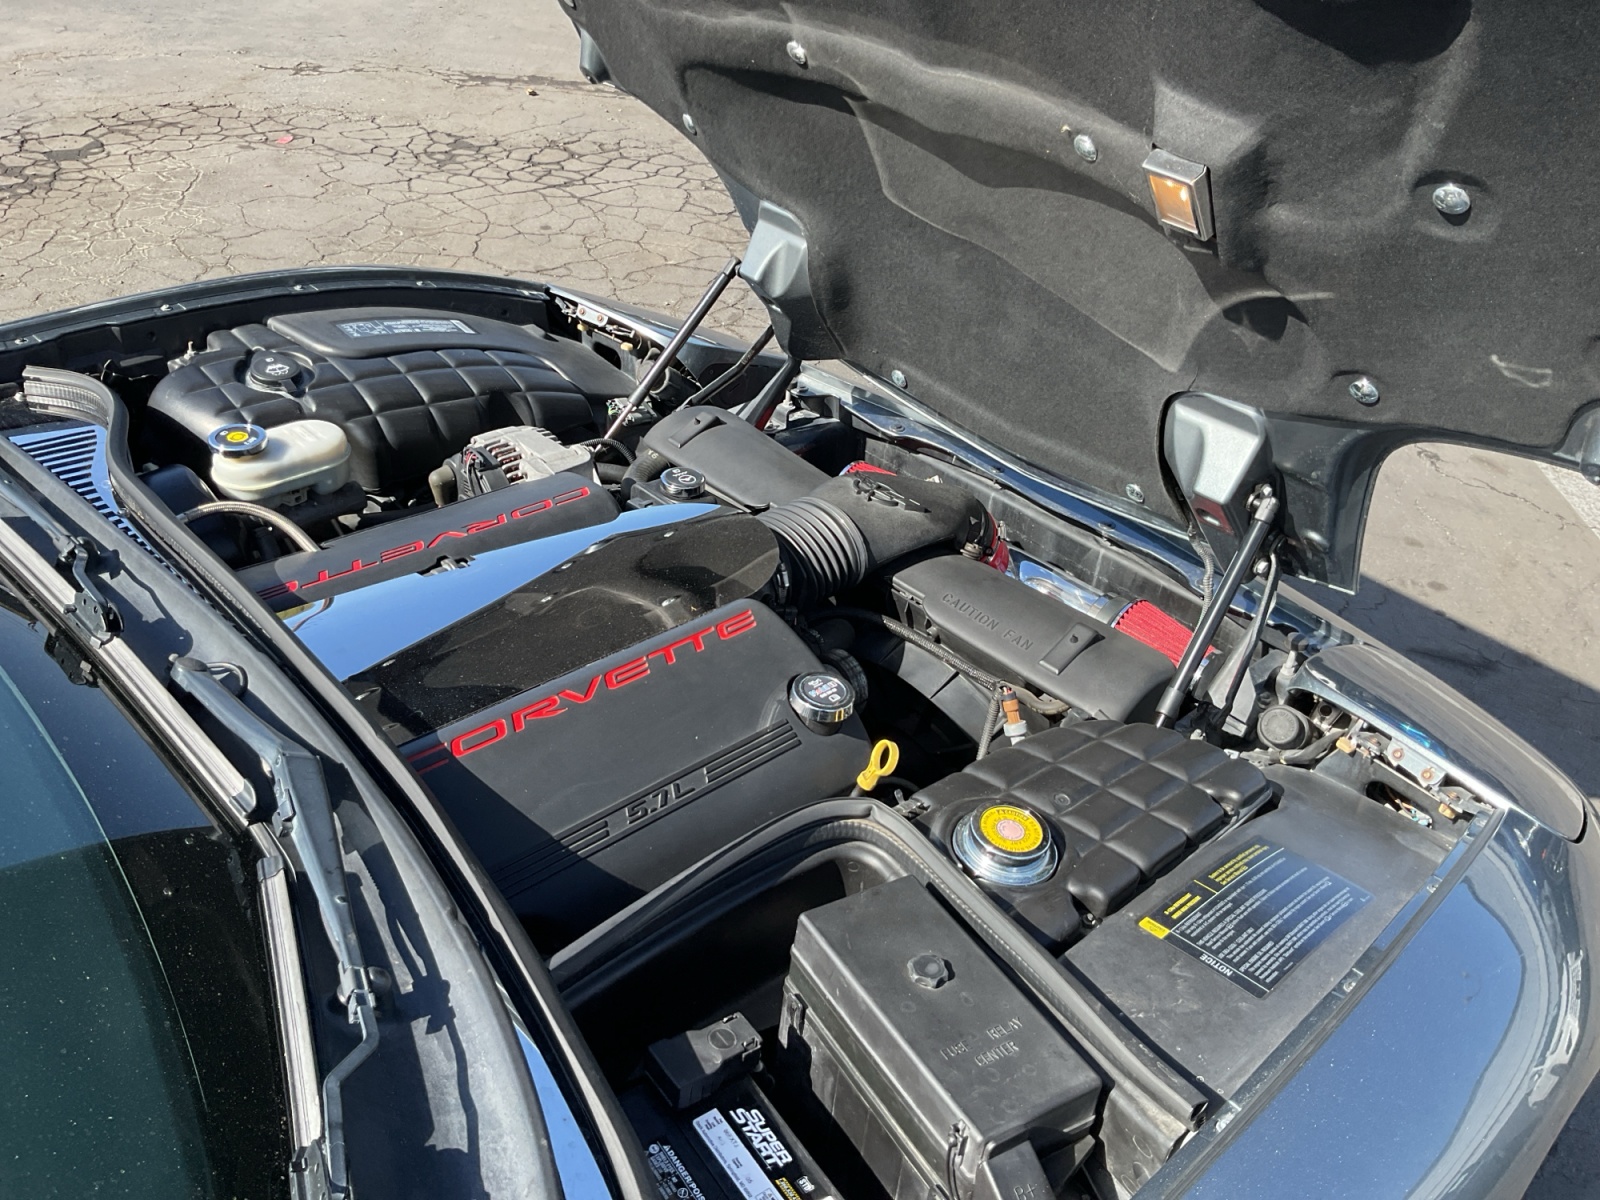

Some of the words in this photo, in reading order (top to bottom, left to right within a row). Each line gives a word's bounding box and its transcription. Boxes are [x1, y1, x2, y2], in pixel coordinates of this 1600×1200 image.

[942, 593, 1000, 631] CAUTION
[1003, 629, 1034, 651] FAN
[626, 779, 696, 825] 5.7L
[1199, 953, 1234, 977] NOTICE
[940, 1040, 973, 1060] FUSE
[986, 1016, 1022, 1040] RELAY
[974, 1041, 1019, 1066] CENTER
[729, 1108, 783, 1168] START
[745, 1108, 793, 1164] SUPER
